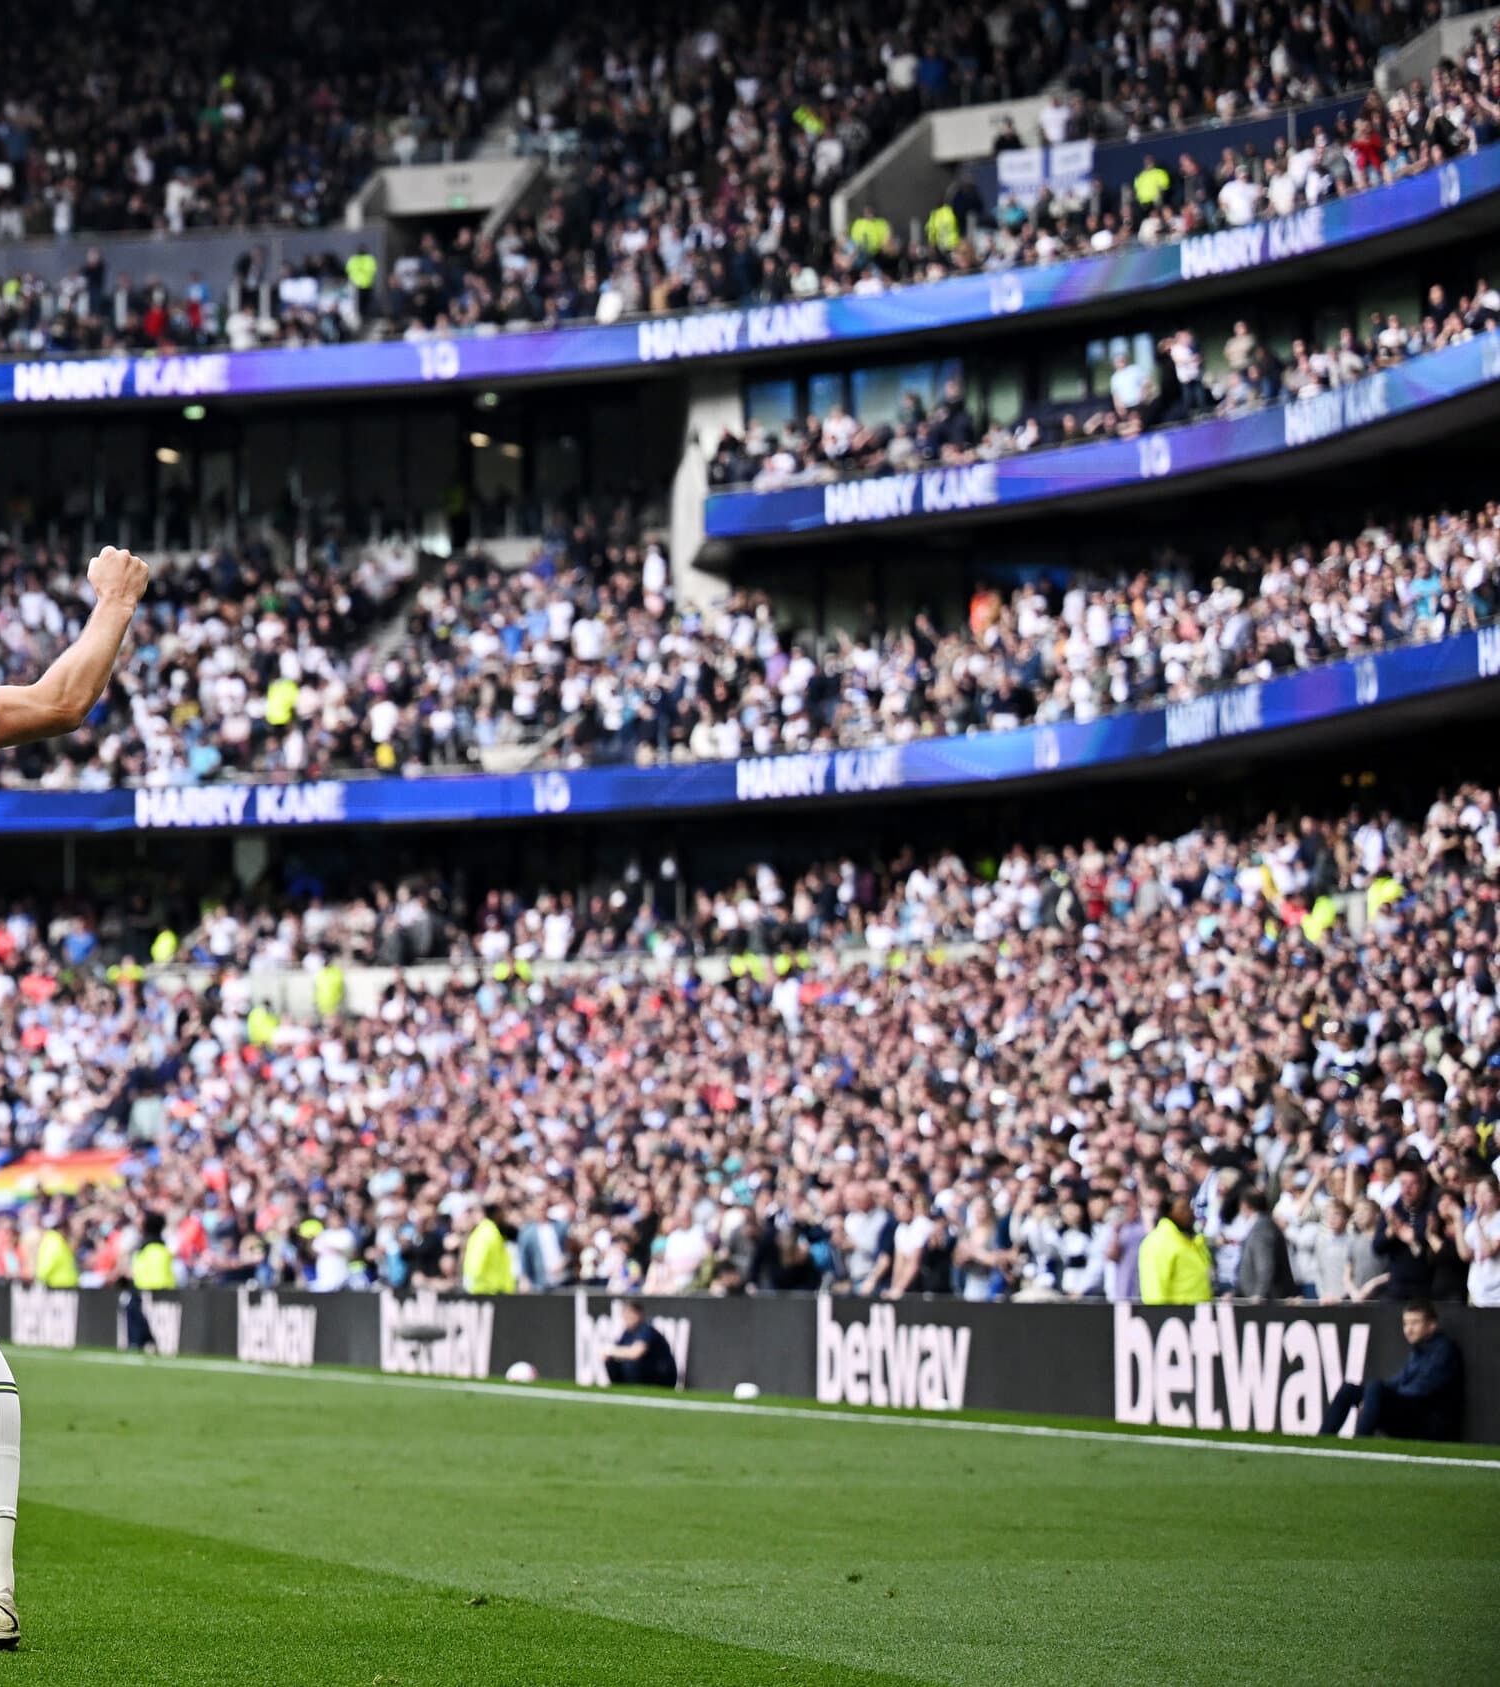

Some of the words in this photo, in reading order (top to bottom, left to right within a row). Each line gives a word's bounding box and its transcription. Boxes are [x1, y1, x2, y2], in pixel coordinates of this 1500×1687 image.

[1180, 222, 1265, 280] HARRY
[1268, 206, 1324, 261] KANE
[638, 311, 743, 361] HARRY
[747, 300, 830, 348] KANE
[14, 359, 128, 401] HARRY
[134, 354, 229, 396] KANE
[825, 474, 917, 525] HARRY
[922, 463, 998, 512] KANE
[134, 785, 250, 828] HARRY
[256, 780, 345, 824] KANE
[736, 754, 832, 801] HARRY
[816, 1294, 972, 1411] betway
[1114, 1300, 1370, 1439] betway
